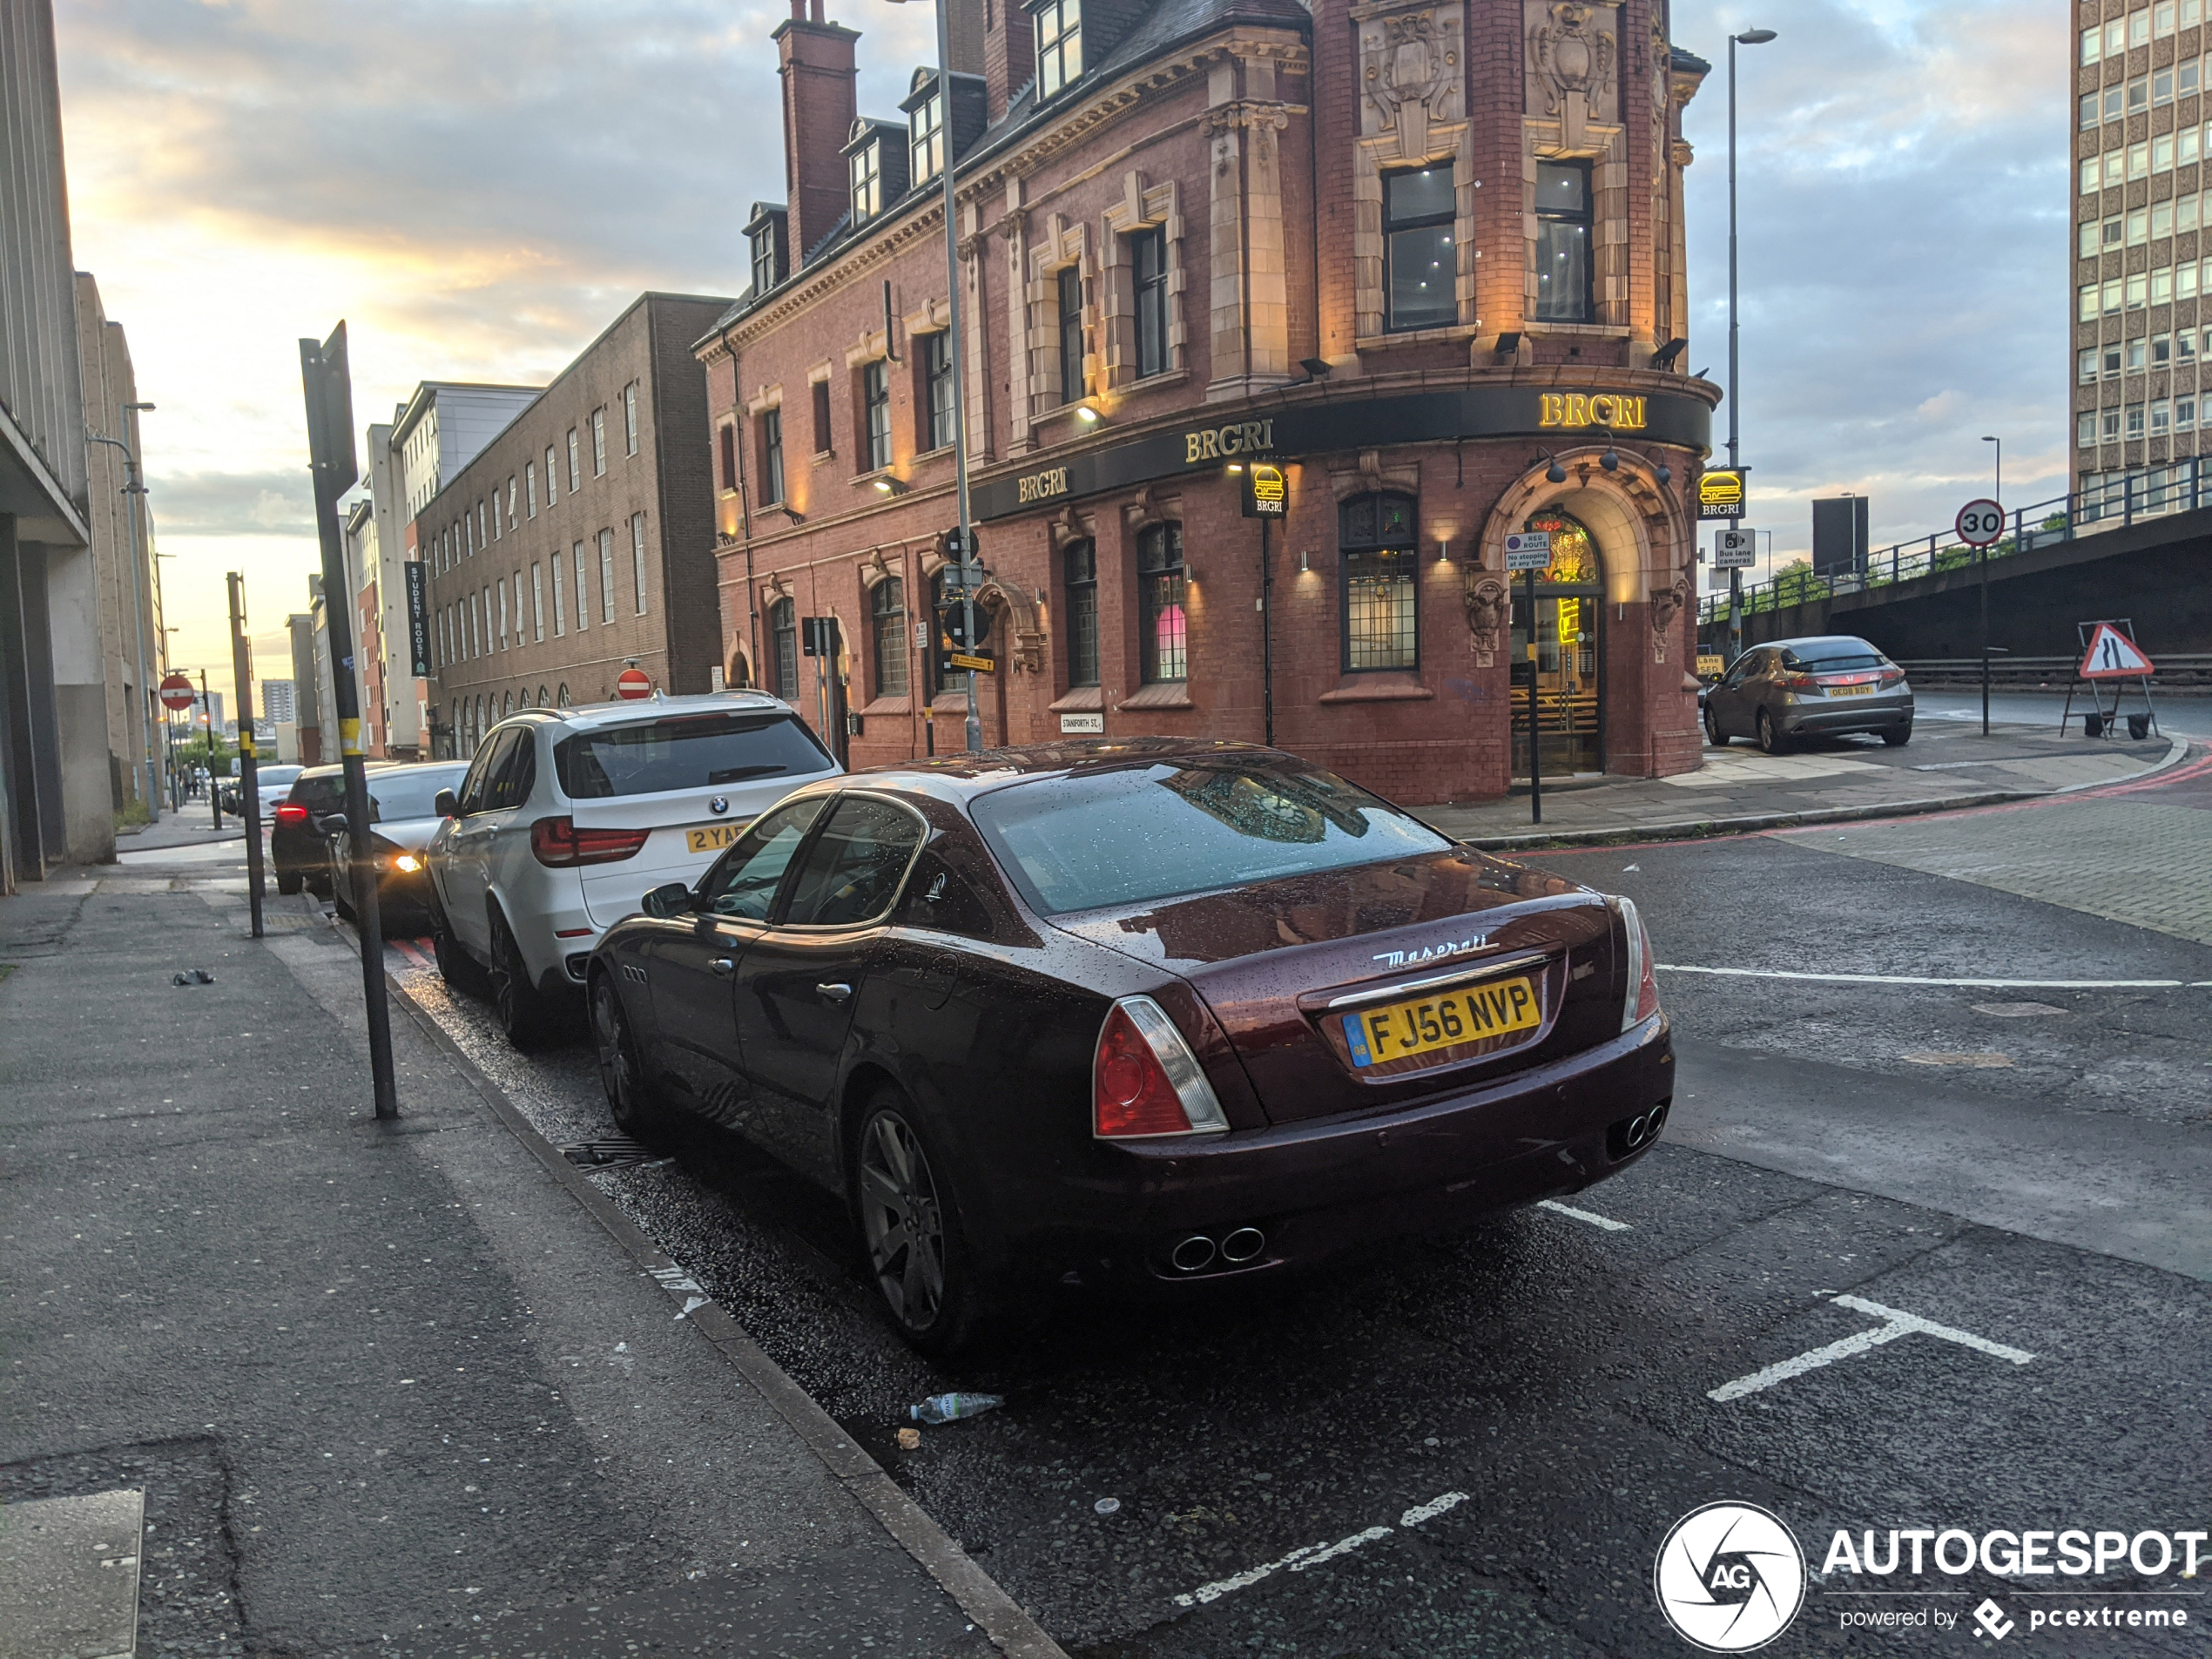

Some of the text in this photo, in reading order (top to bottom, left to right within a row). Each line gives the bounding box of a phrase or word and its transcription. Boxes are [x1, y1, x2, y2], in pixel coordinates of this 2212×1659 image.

[1540, 393, 1647, 427] BRGRI
[1185, 419, 1274, 462] BRGRI
[1019, 467, 1068, 503] BRGRI
[1257, 500, 1282, 512] BRGRI
[1703, 504, 1739, 516] BRGRI
[1963, 513, 1999, 532] 30
[411, 567, 423, 658] STUDENT ROOST
[1062, 718, 1089, 727] STANIFORTH
[694, 832, 707, 848] 2
[1373, 934, 1500, 968] Maserati
[1369, 984, 1528, 1055] FJ56 NVP
